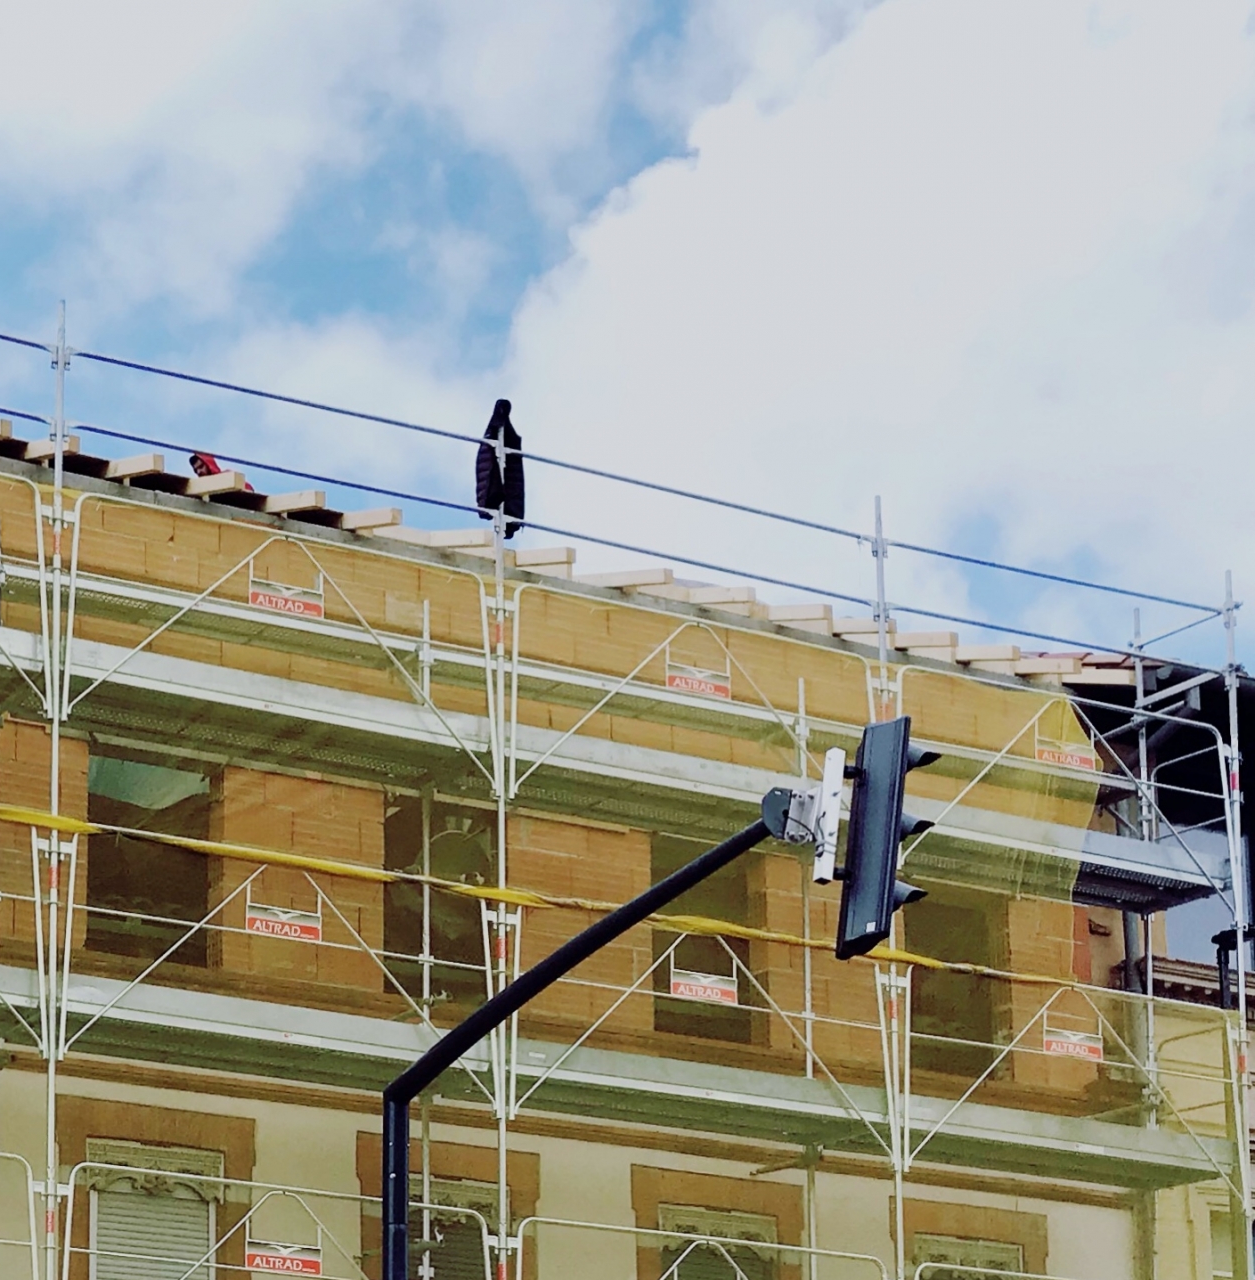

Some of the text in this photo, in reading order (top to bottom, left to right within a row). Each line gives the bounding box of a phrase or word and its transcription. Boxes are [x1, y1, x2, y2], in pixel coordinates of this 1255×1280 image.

[256, 595, 304, 613] ALTRAD
[673, 677, 715, 694] ALTRAD
[1042, 750, 1080, 766] ALTRAD
[253, 920, 301, 937] ALTRAD
[677, 985, 721, 1000] ALTRAD
[1050, 1041, 1088, 1055] ALTRAD
[253, 1256, 303, 1271] ALTRAD
